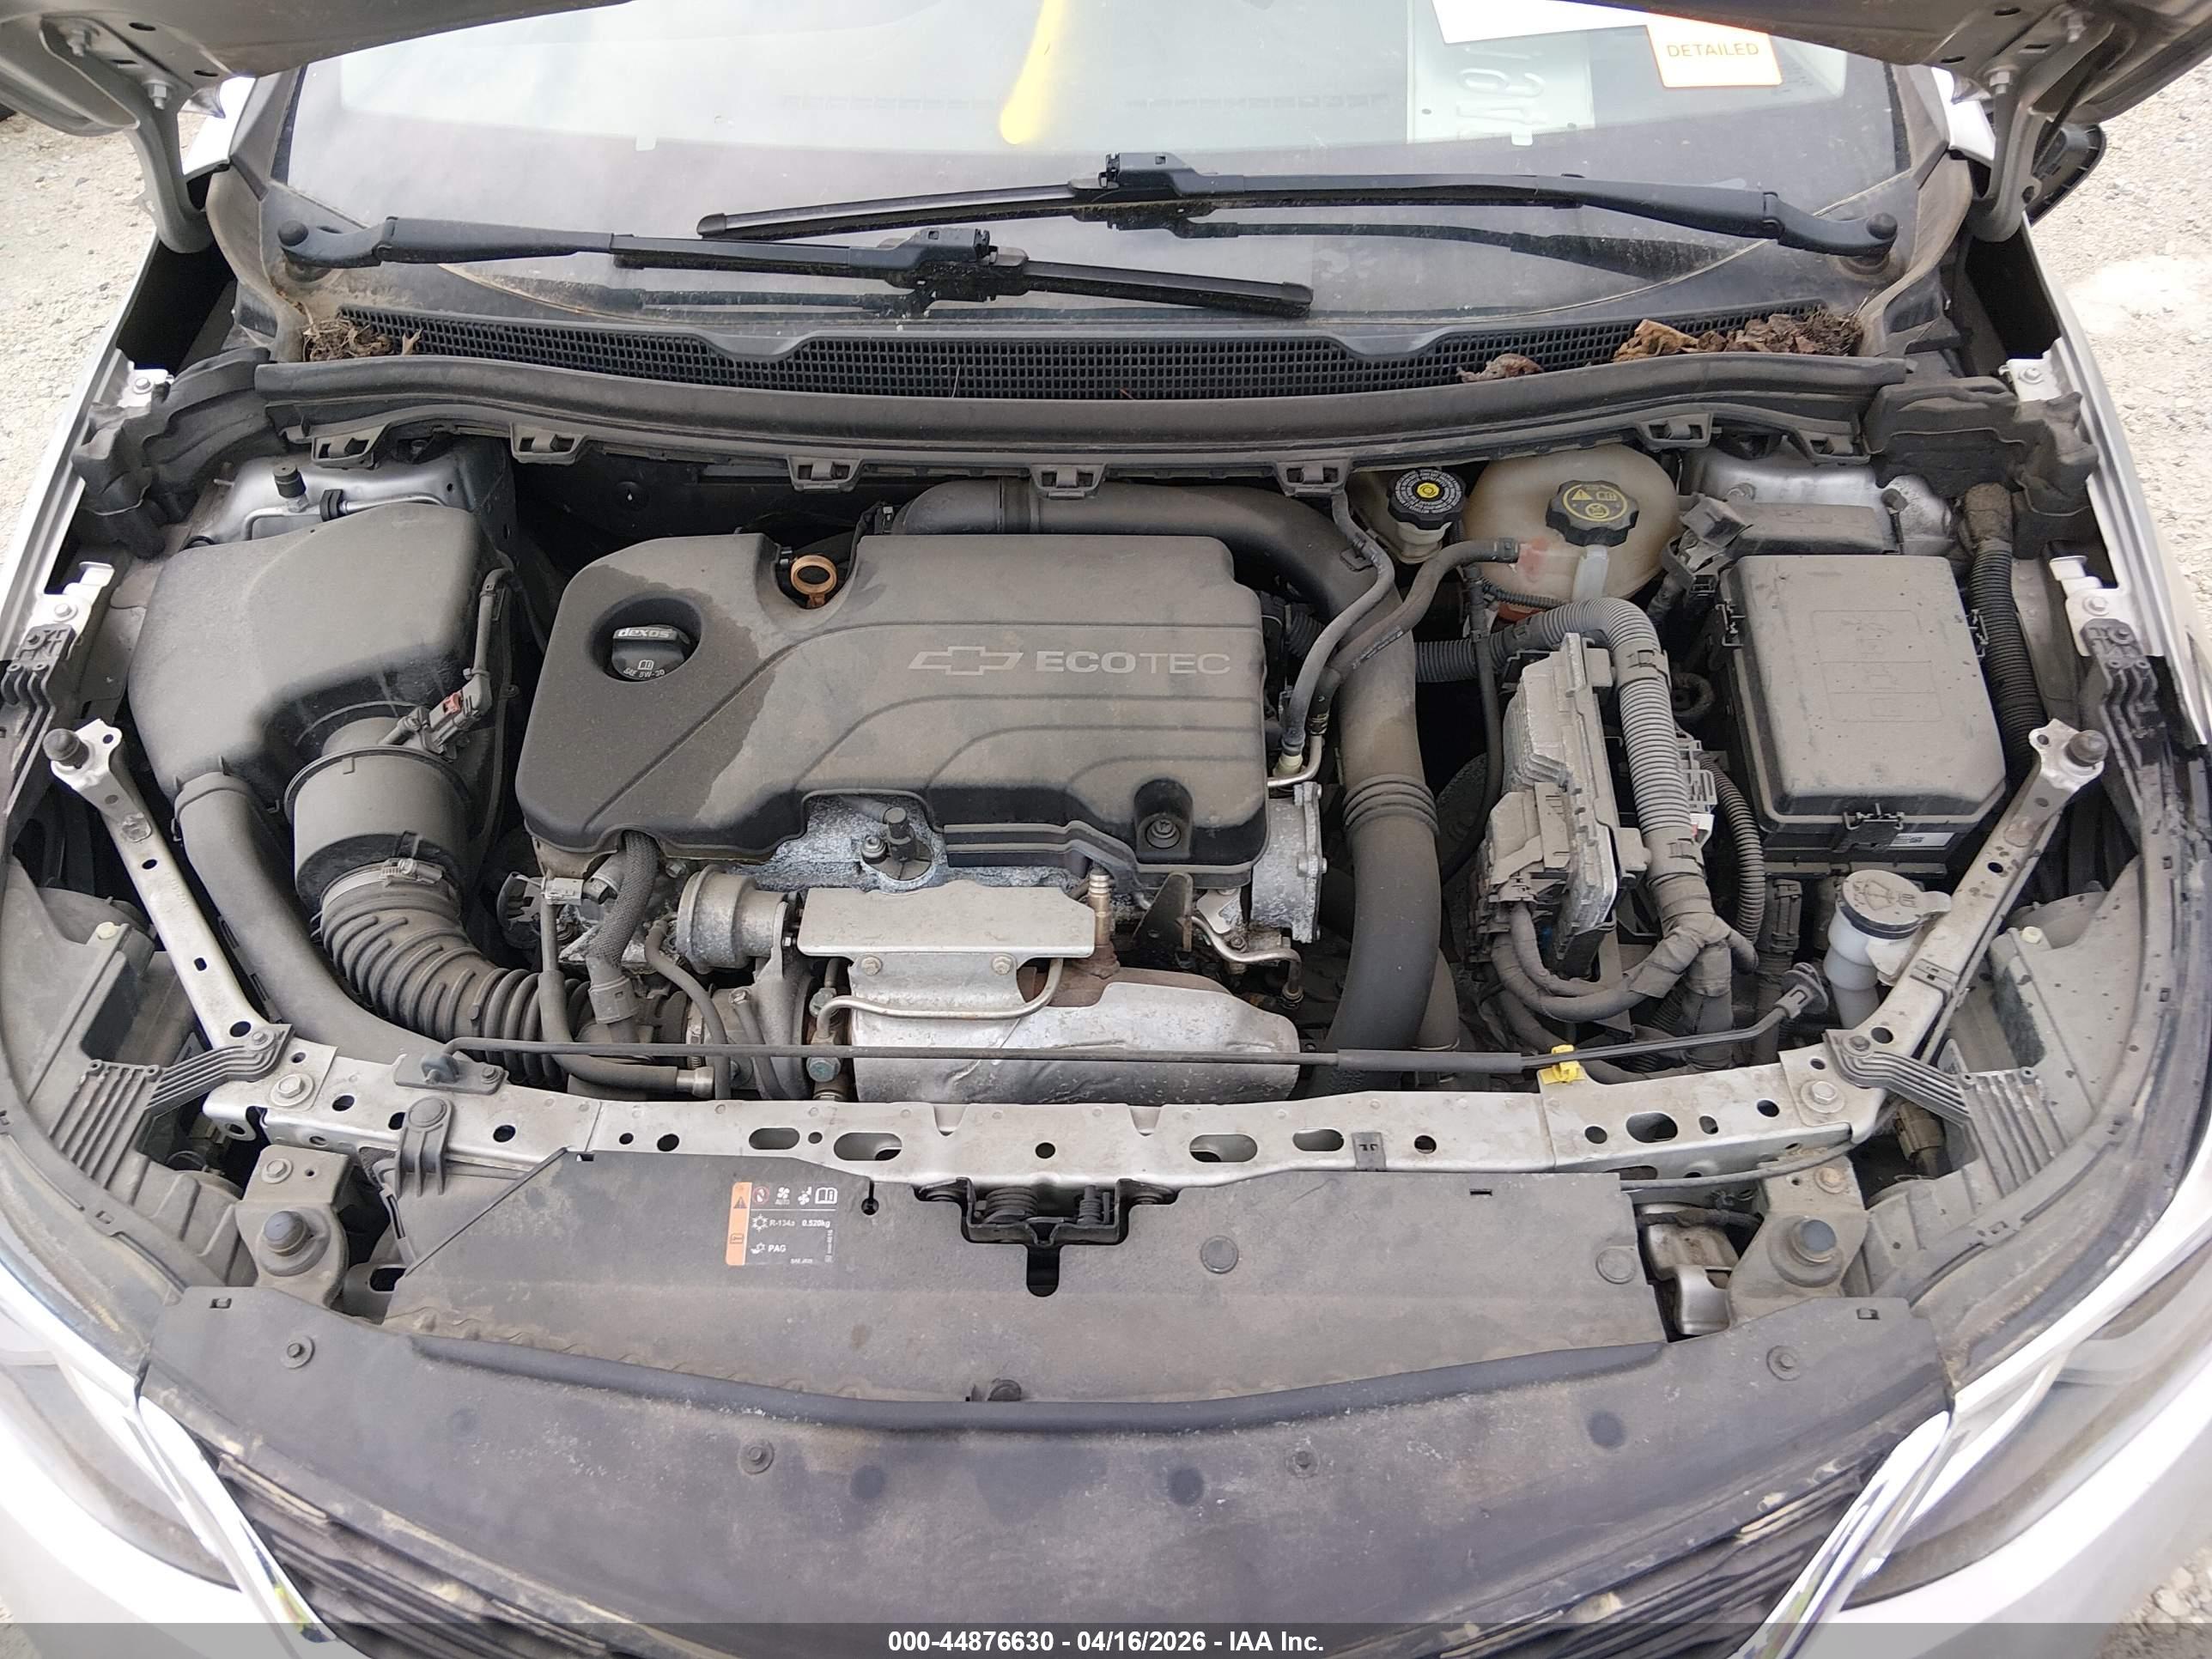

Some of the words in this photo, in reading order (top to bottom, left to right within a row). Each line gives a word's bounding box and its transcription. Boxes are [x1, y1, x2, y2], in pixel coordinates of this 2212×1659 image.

[1666, 43, 1759, 58] DETAILED
[618, 628, 671, 638] dexos
[1035, 650, 1231, 675] ECOTEC
[623, 668, 637, 677] SAE
[639, 669, 665, 678] 5W-30
[768, 1244, 787, 1253] PAG
